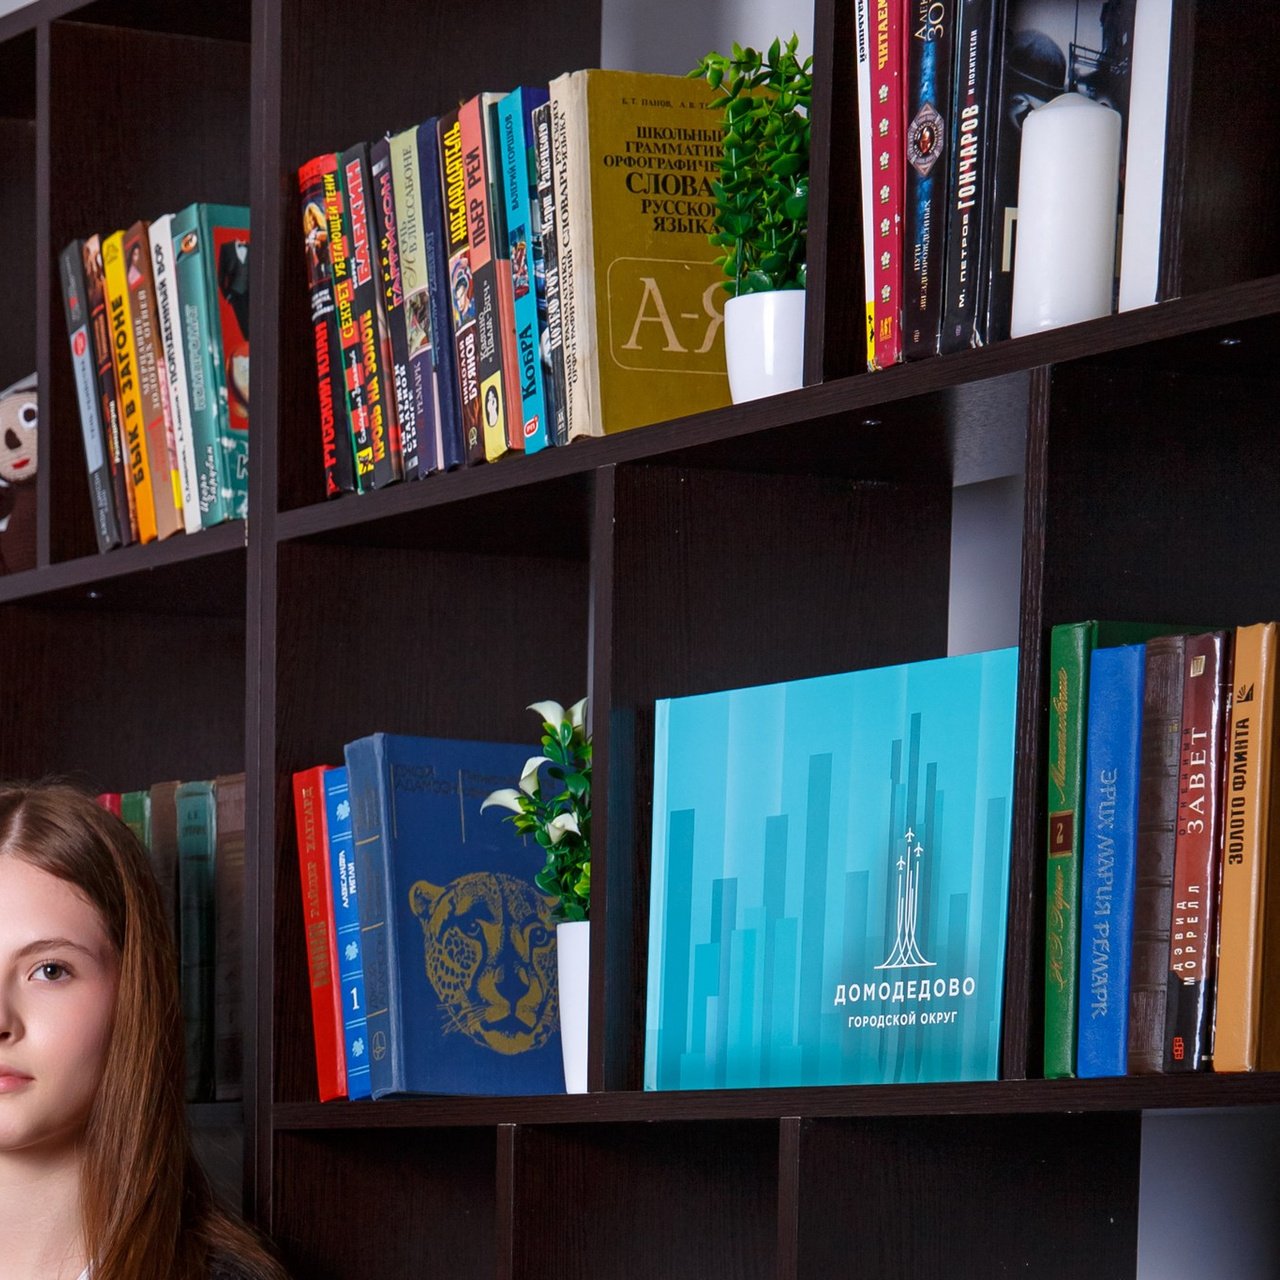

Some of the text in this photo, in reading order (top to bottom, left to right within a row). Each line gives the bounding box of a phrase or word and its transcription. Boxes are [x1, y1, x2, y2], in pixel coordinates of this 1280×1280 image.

[444, 121, 467, 244] НАБЛЮДАТЕЛЬ
[505, 114, 519, 211] ВАЛЕРИЙ ГОРШКОВ
[560, 112, 568, 166] ЯЗЫКА
[346, 158, 372, 286] БАБКИН
[403, 145, 417, 240] ЛИССАБОНЕ
[465, 146, 487, 249] ПЬЕР РЕЙ
[559, 167, 572, 247] СЛОВАРЬ
[653, 217, 720, 234] ЯЗЫКА
[958, 103, 979, 308] М. ПЕТРОВ ГОНЧАРОВ
[324, 174, 354, 339] СЕКРЕТ УБЕГАЮЩЕЙ ТЕНИ
[380, 172, 403, 308] ГАРРИСОН
[545, 267, 559, 298] РОТ
[913, 244, 922, 271] ПУТИ
[111, 295, 133, 394] ЗАГОНЕ
[154, 243, 177, 385] ПОЛУДЕННЫЙ ВОР
[315, 321, 330, 376] КЛАН
[359, 311, 385, 463] КРОВЬ НА ЗОЛОТЕ
[465, 333, 477, 400] БУЯНОВ
[520, 323, 536, 400] КОБРА
[124, 402, 136, 419] В
[128, 424, 145, 486] БЫК
[320, 378, 336, 468] РУССКИЙ
[1187, 727, 1207, 835] ЗАВЕТ
[1228, 717, 1250, 865] ЗОЛОТО ФЛИНТА
[1091, 919, 1112, 1019] РЕМАРК
[1173, 901, 1186, 972] ДЭВИД
[1184, 884, 1200, 986] МОРРЕЛЛ
[351, 987, 360, 1010] 1
[834, 977, 975, 1006] ДОМОДЕДОВО
[848, 1011, 958, 1028] ГОРОДСКОЙ ОКРУГ
